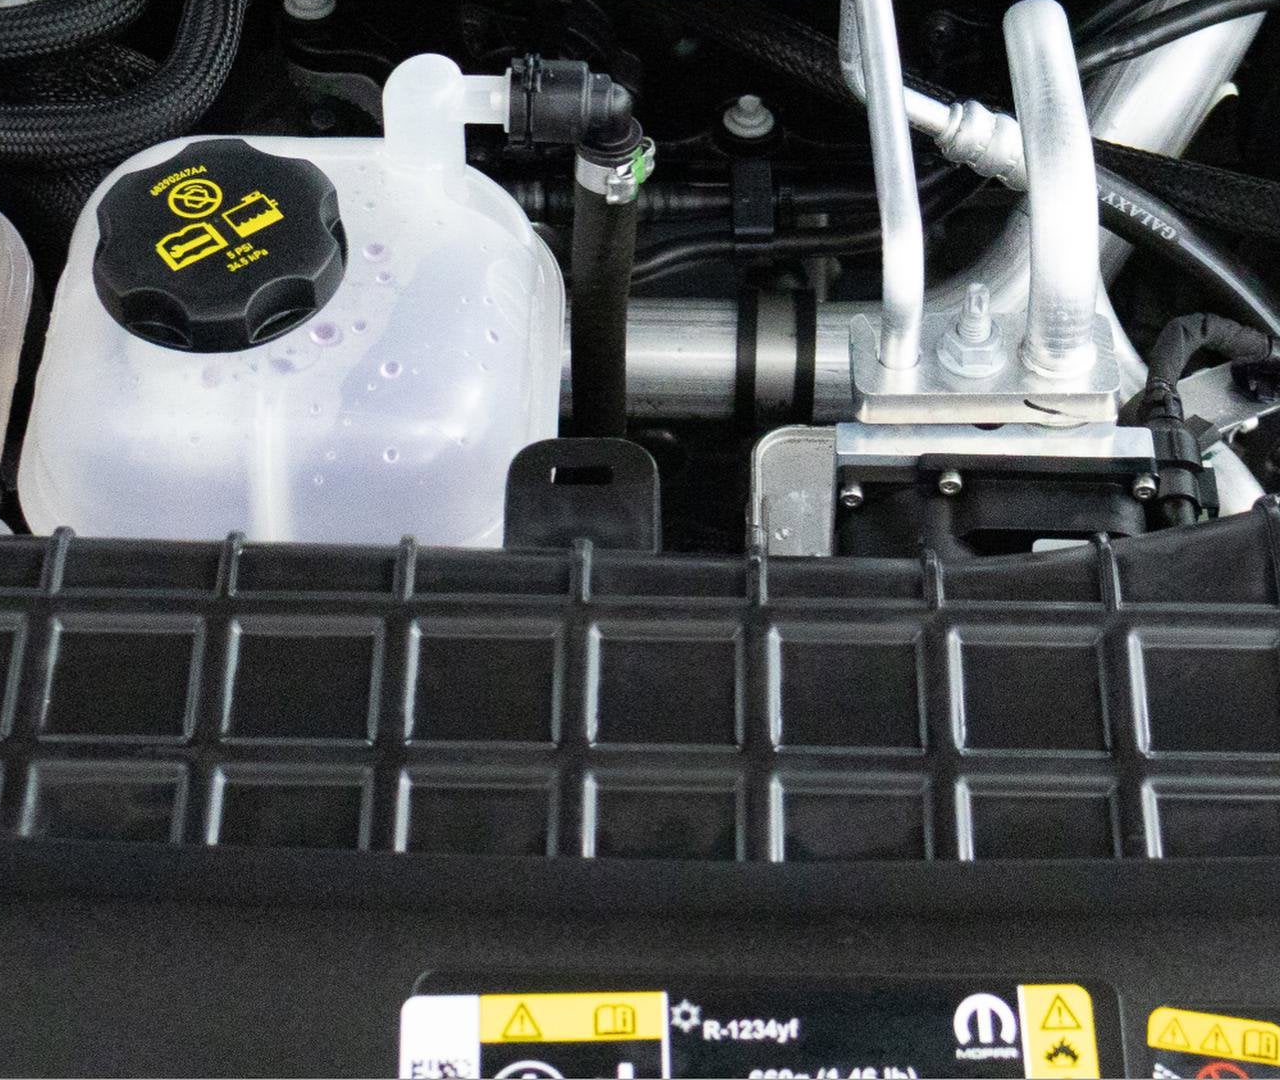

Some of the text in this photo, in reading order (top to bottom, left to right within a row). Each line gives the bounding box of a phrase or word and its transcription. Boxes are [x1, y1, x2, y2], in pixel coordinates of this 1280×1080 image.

[1101, 191, 1177, 240] GALAXY
[226, 242, 253, 260] 5 PSI
[226, 248, 269, 272] 34.5 kPa
[702, 1018, 800, 1043] R-1234yf
[955, 1047, 1019, 1061] MOPAR
